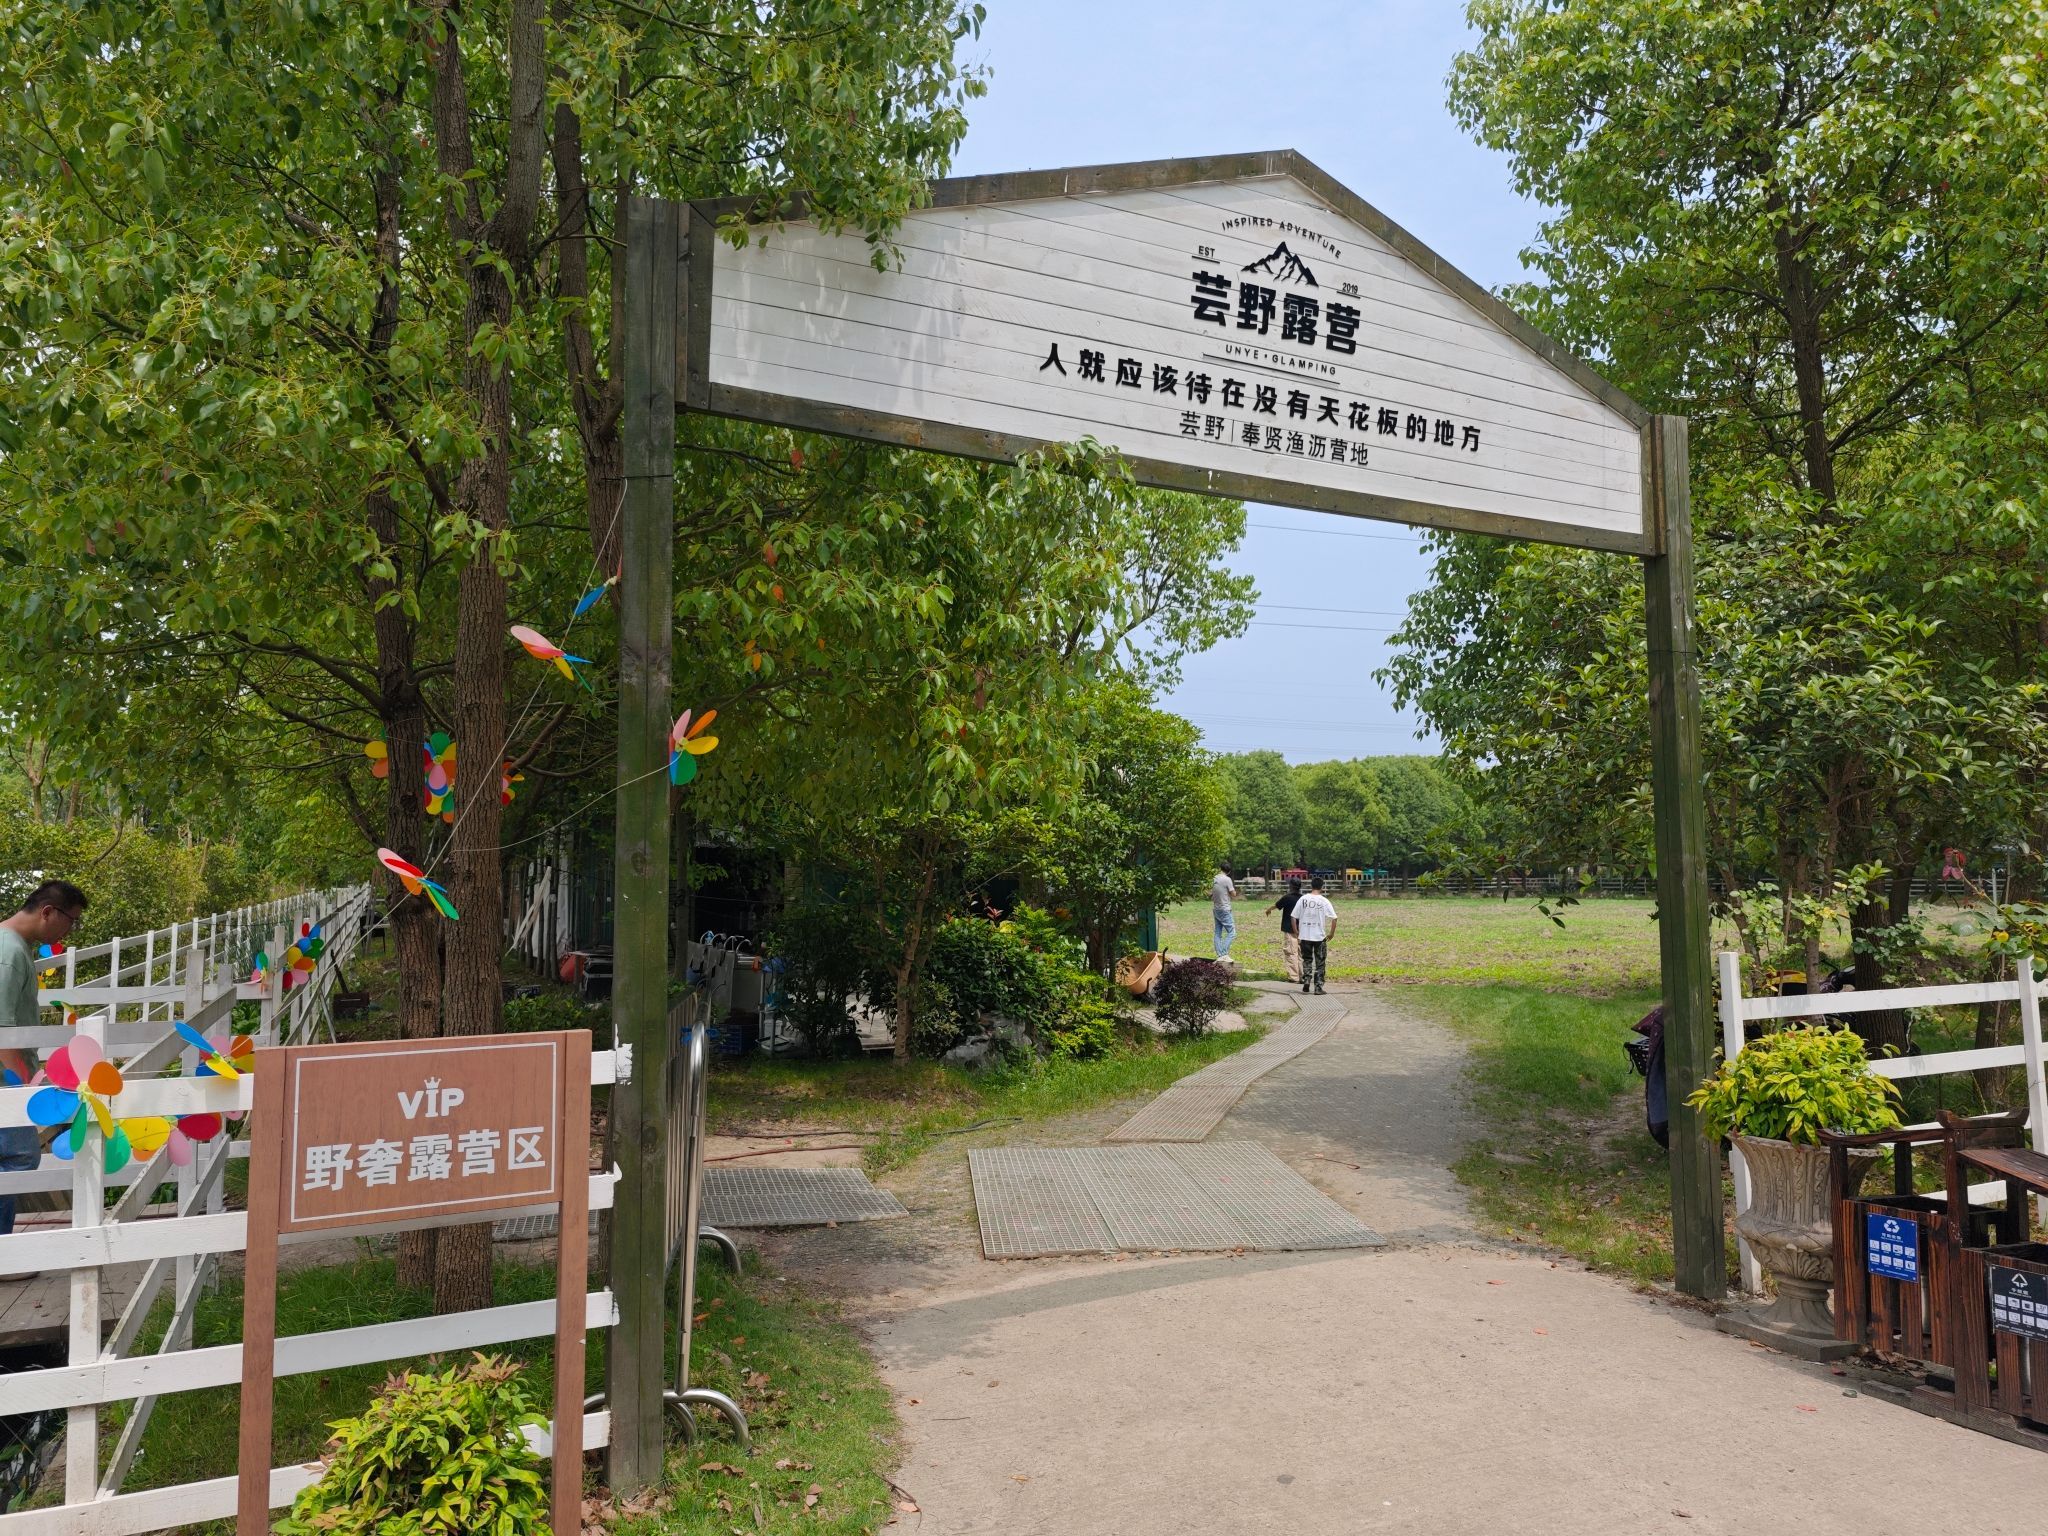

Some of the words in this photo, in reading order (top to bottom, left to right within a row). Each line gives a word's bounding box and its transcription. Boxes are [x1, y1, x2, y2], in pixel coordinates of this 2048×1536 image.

[1198, 245, 1216, 258] EST
[1222, 216, 1273, 231] INSPIRED
[1279, 221, 1342, 259] ADVENTURE
[1342, 282, 1359, 295] 2019
[1190, 270, 1361, 355] 芸野露营
[1039, 342, 1481, 453] 人就应该待在没有天花板的地方
[397, 1083, 465, 1120] VIP
[302, 1126, 546, 1192] 野奢露营区
